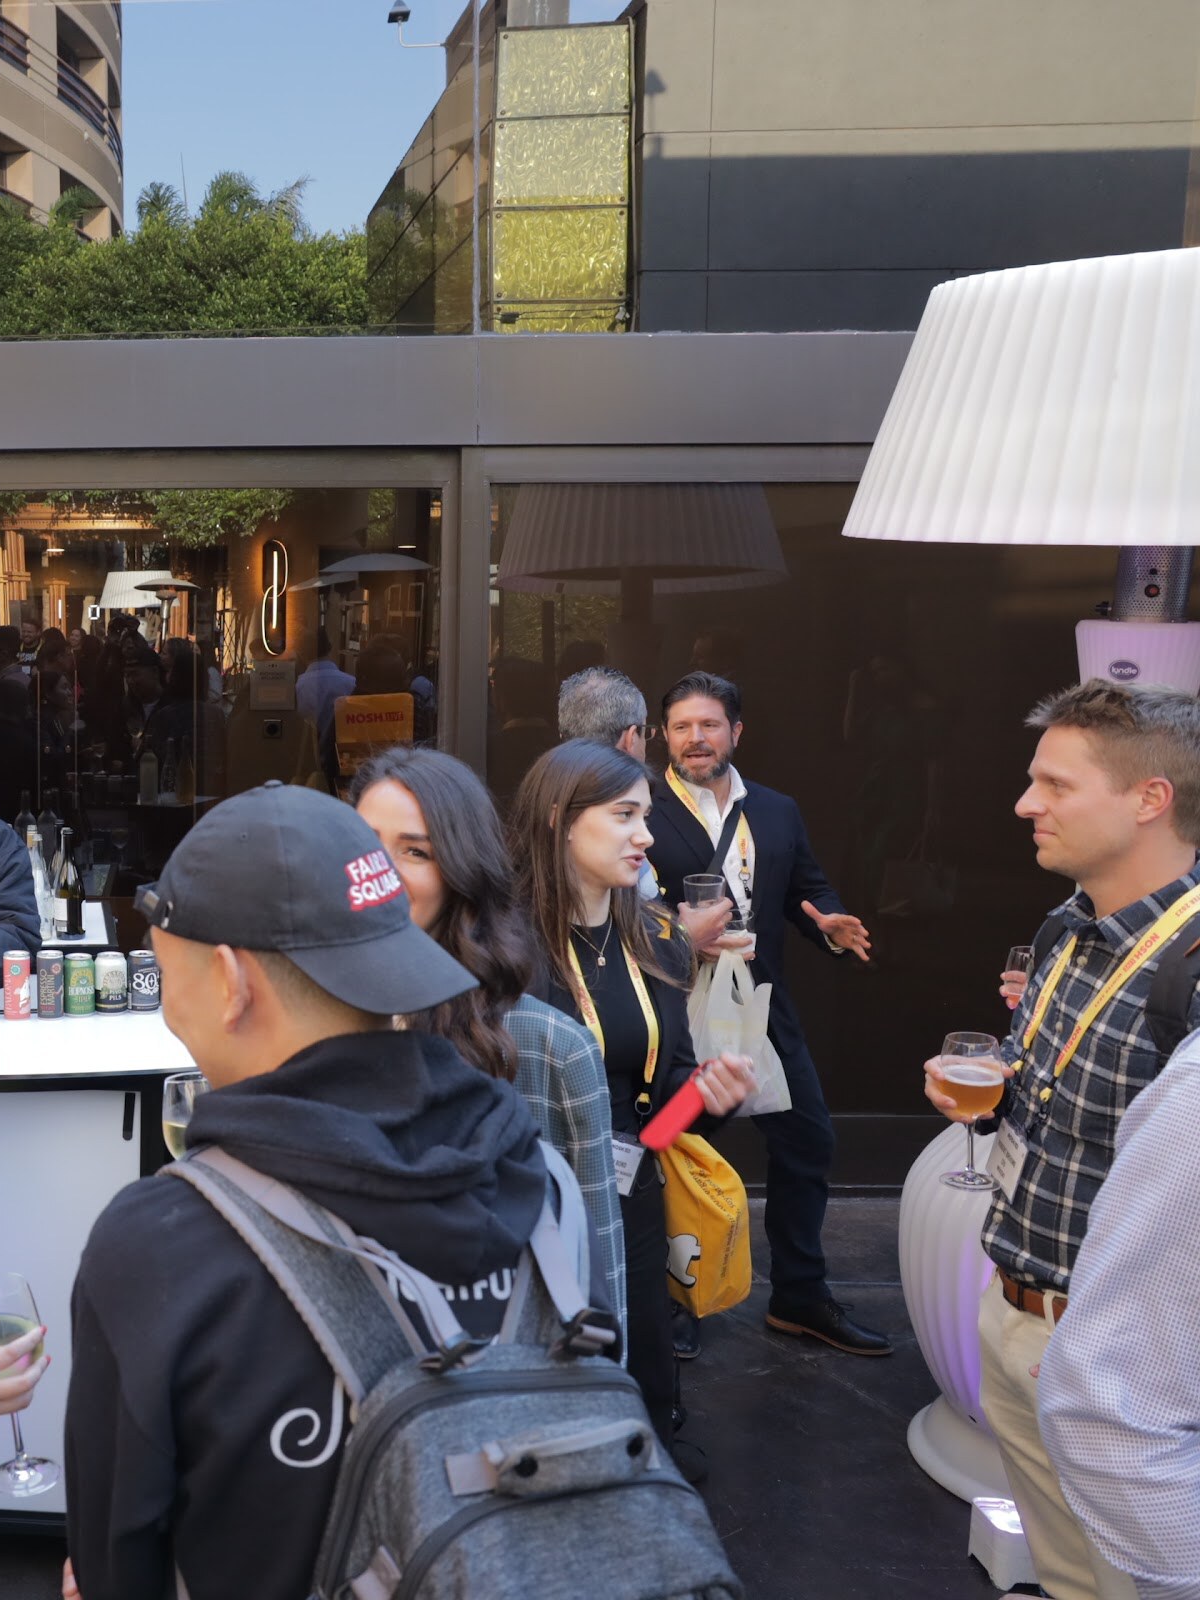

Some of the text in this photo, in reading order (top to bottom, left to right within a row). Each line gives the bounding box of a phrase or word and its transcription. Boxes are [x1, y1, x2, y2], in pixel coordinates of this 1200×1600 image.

[346, 712, 384, 725] NOSH
[346, 850, 390, 883] FAIR
[1175, 900, 1193, 918] 2023
[1135, 932, 1161, 963] NOSH
[40, 968, 48, 1006] ESPRESSO
[47, 974, 56, 1006] MARTINI
[132, 972, 159, 990] 80
[1062, 1025, 1082, 1056] NOSH
